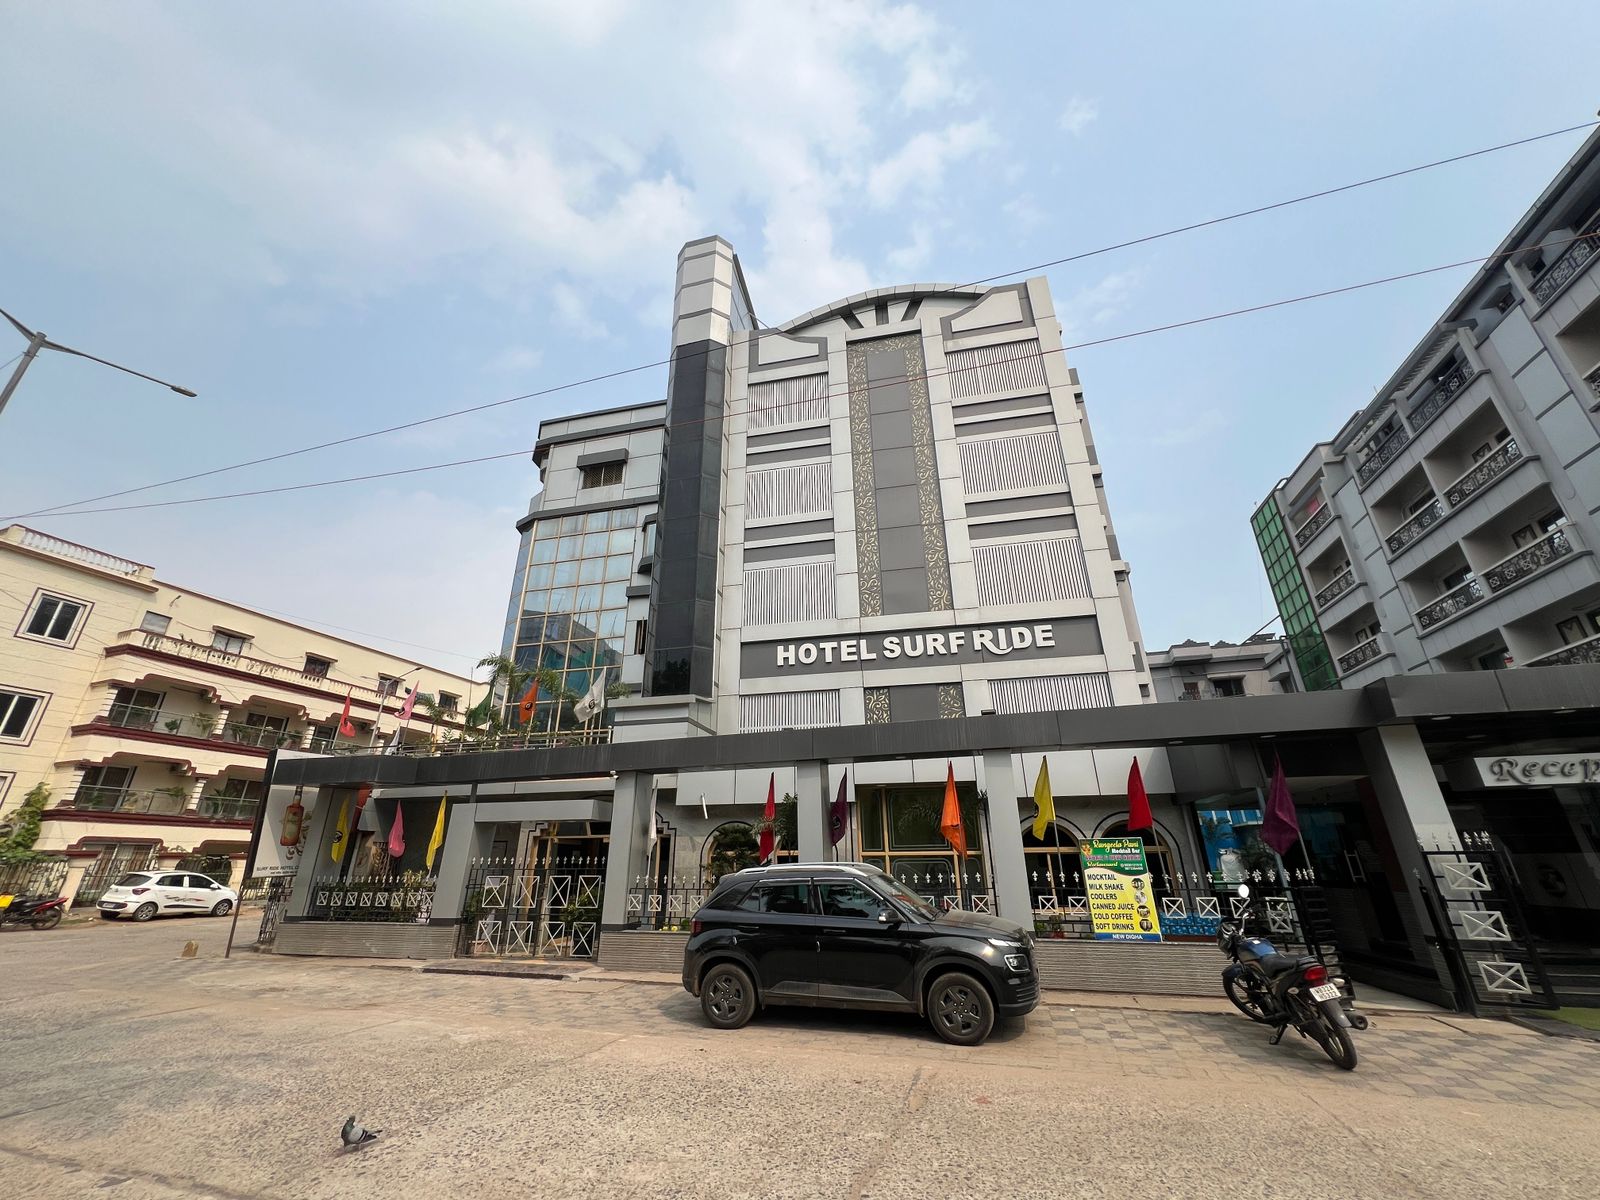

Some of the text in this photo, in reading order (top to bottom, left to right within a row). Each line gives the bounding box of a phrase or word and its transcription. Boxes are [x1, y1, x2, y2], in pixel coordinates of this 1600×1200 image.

[776, 624, 1056, 667] HOTEL SURF RIDE
[1087, 873, 1117, 881] MOCKTAIL
[1104, 883, 1125, 891] SHAKE
[1117, 903, 1135, 911] JUICE
[1110, 913, 1134, 921] COFFEE
[1095, 922, 1135, 931] SOFT DRINKS
